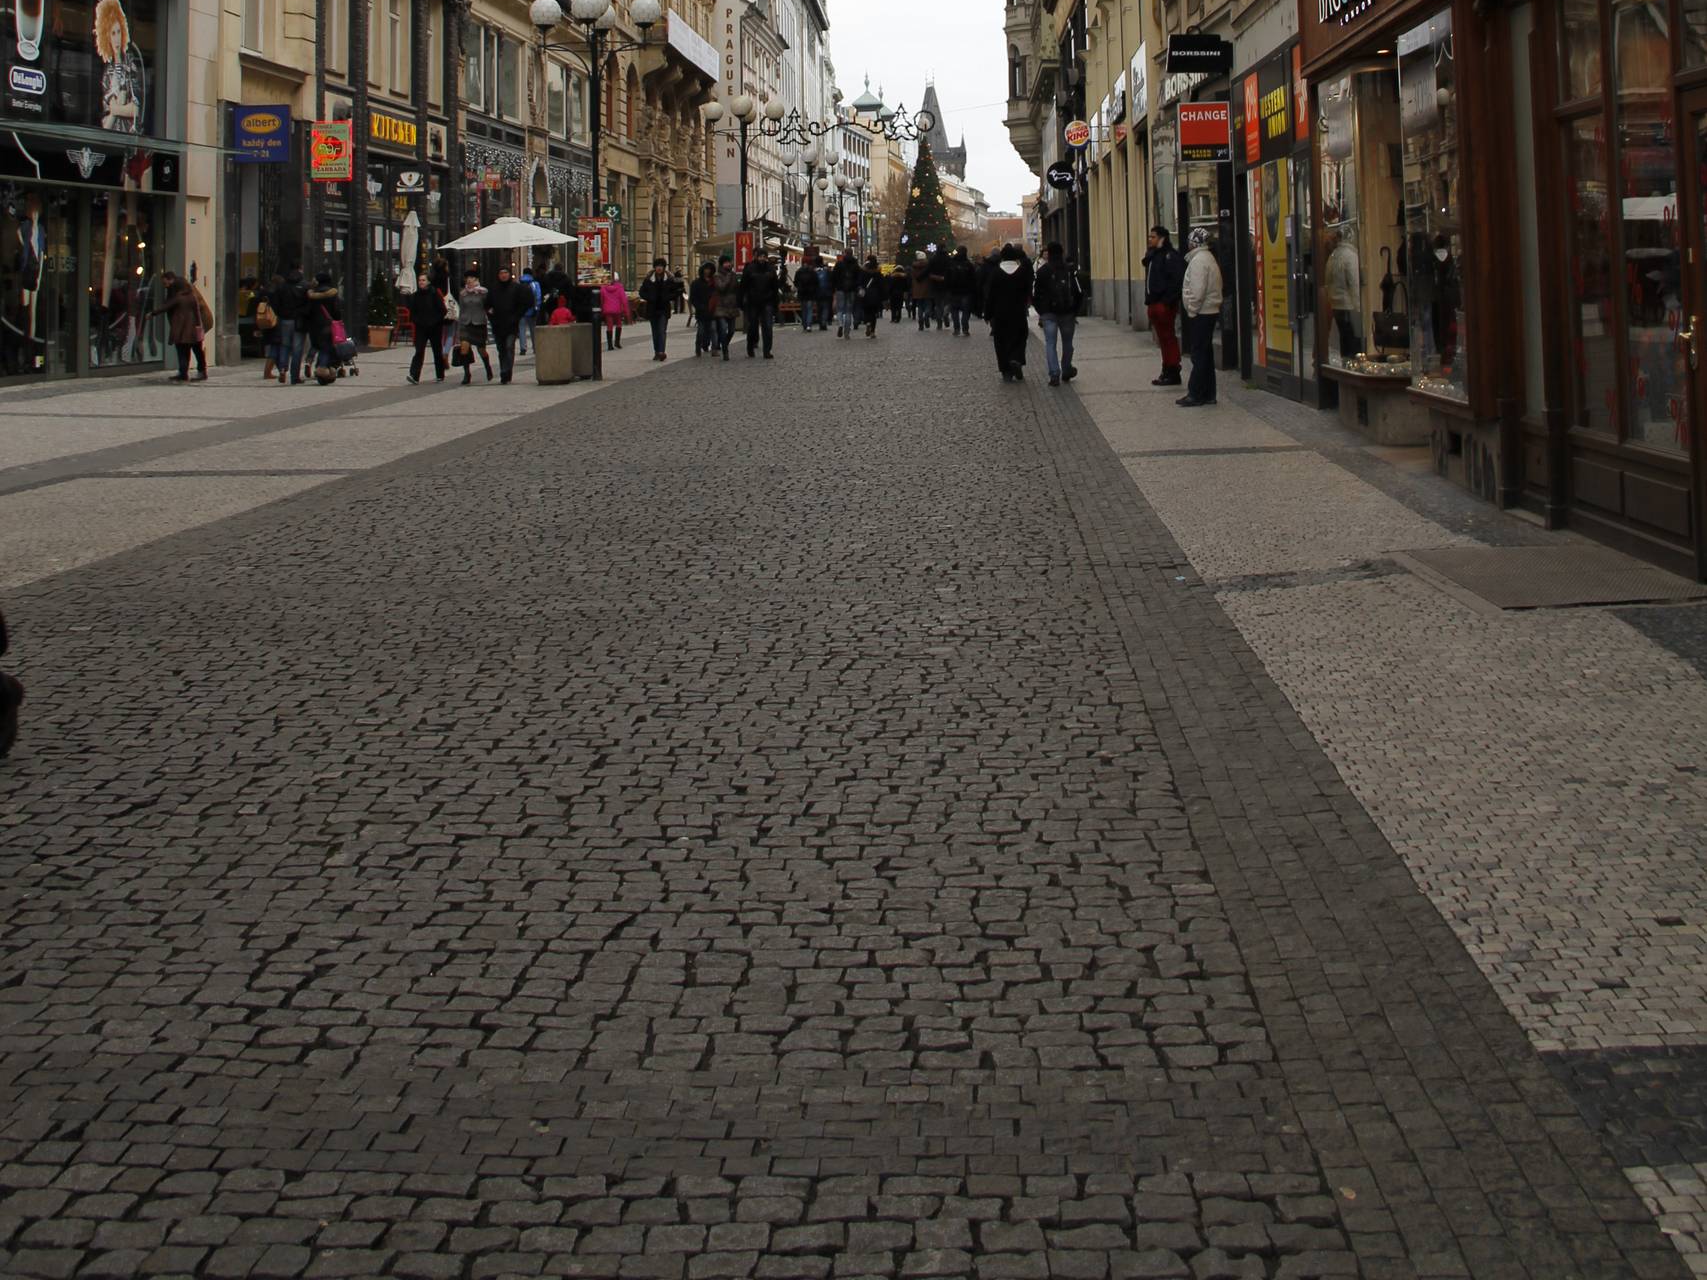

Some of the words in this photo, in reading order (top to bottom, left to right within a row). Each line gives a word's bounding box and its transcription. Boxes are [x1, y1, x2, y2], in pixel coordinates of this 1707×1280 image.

[725, 8, 734, 96] PRAGUE
[1180, 110, 1227, 121] CHANGE
[1259, 85, 1286, 120] WESTERN
[244, 118, 278, 130] albert
[727, 116, 735, 158] INN
[1067, 130, 1089, 143] KING
[1267, 110, 1287, 139] UNION
